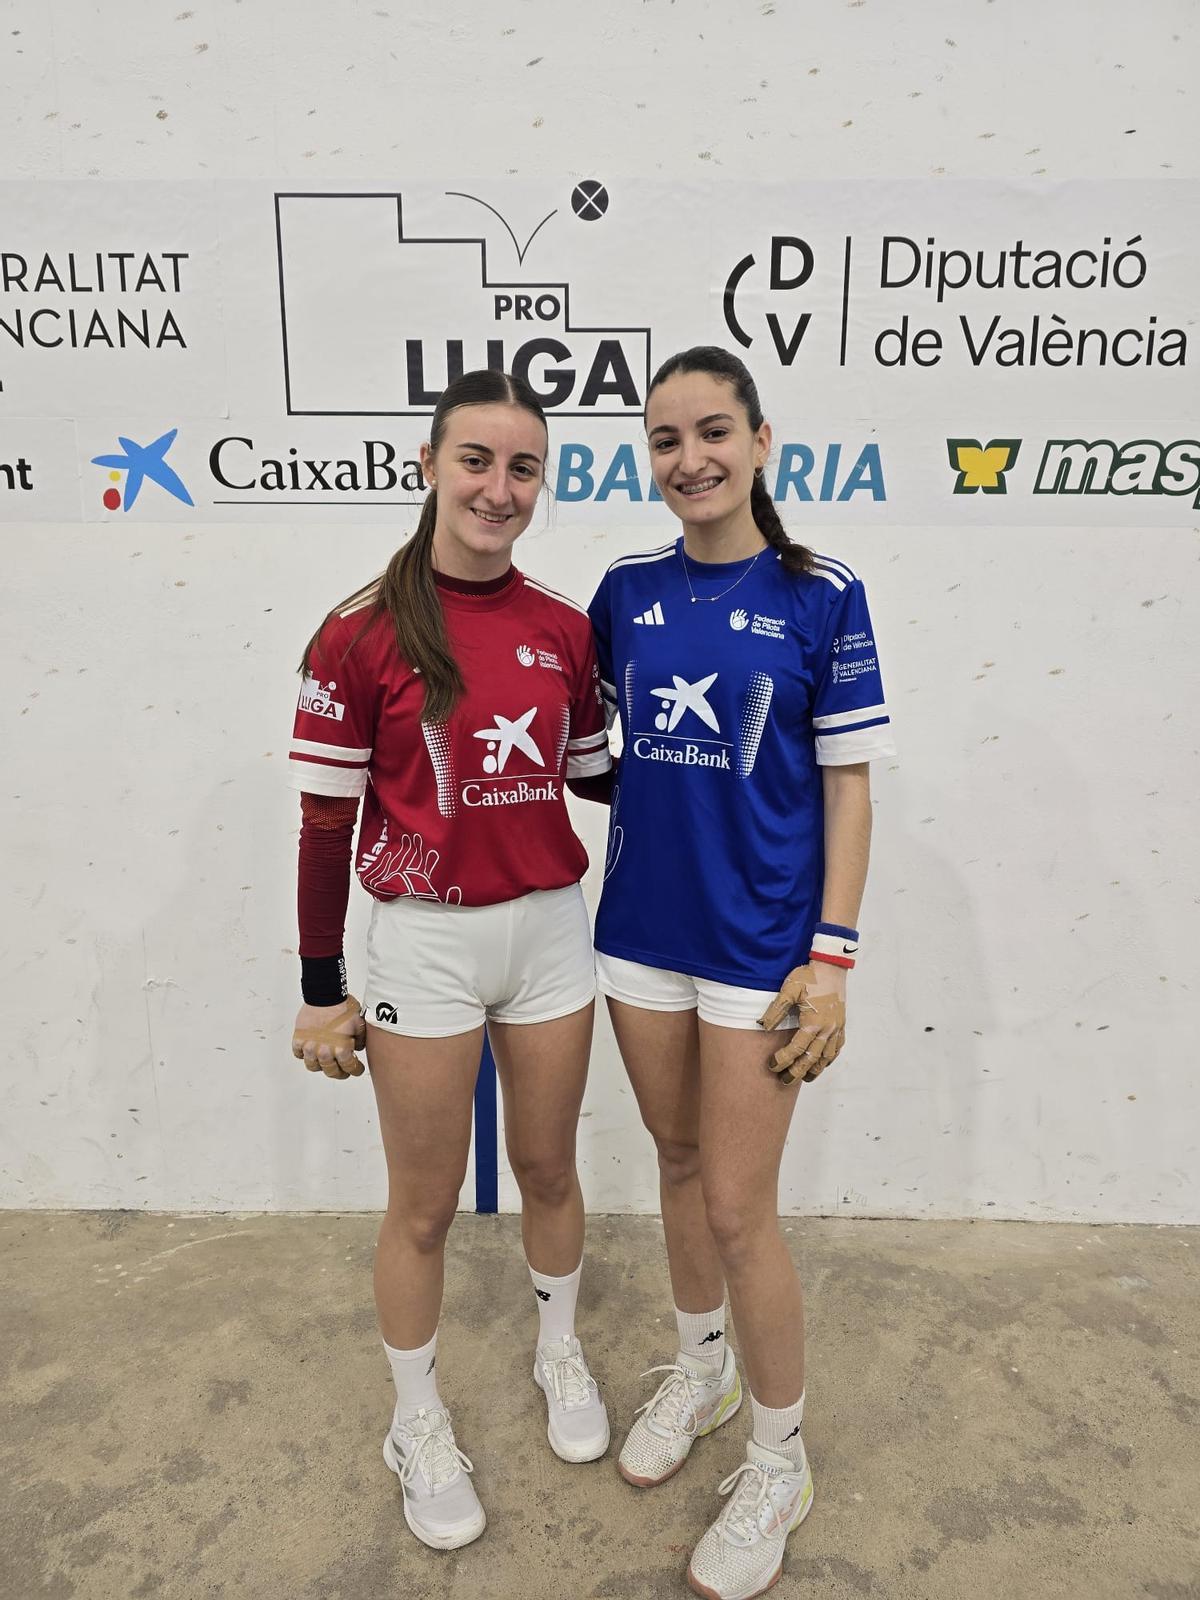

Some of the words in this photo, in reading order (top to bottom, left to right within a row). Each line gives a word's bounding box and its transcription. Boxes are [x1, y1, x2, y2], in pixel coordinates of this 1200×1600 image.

[1, 252, 189, 293] RALITAT
[880, 234, 1147, 303] Diputació
[494, 294, 561, 321] PRO
[874, 315, 943, 367] de
[959, 313, 1187, 367] València
[1032, 438, 1200, 510] mas
[301, 695, 337, 718] LLIGA
[633, 738, 731, 770] CaixaBank
[461, 780, 559, 807] CaixaBank
